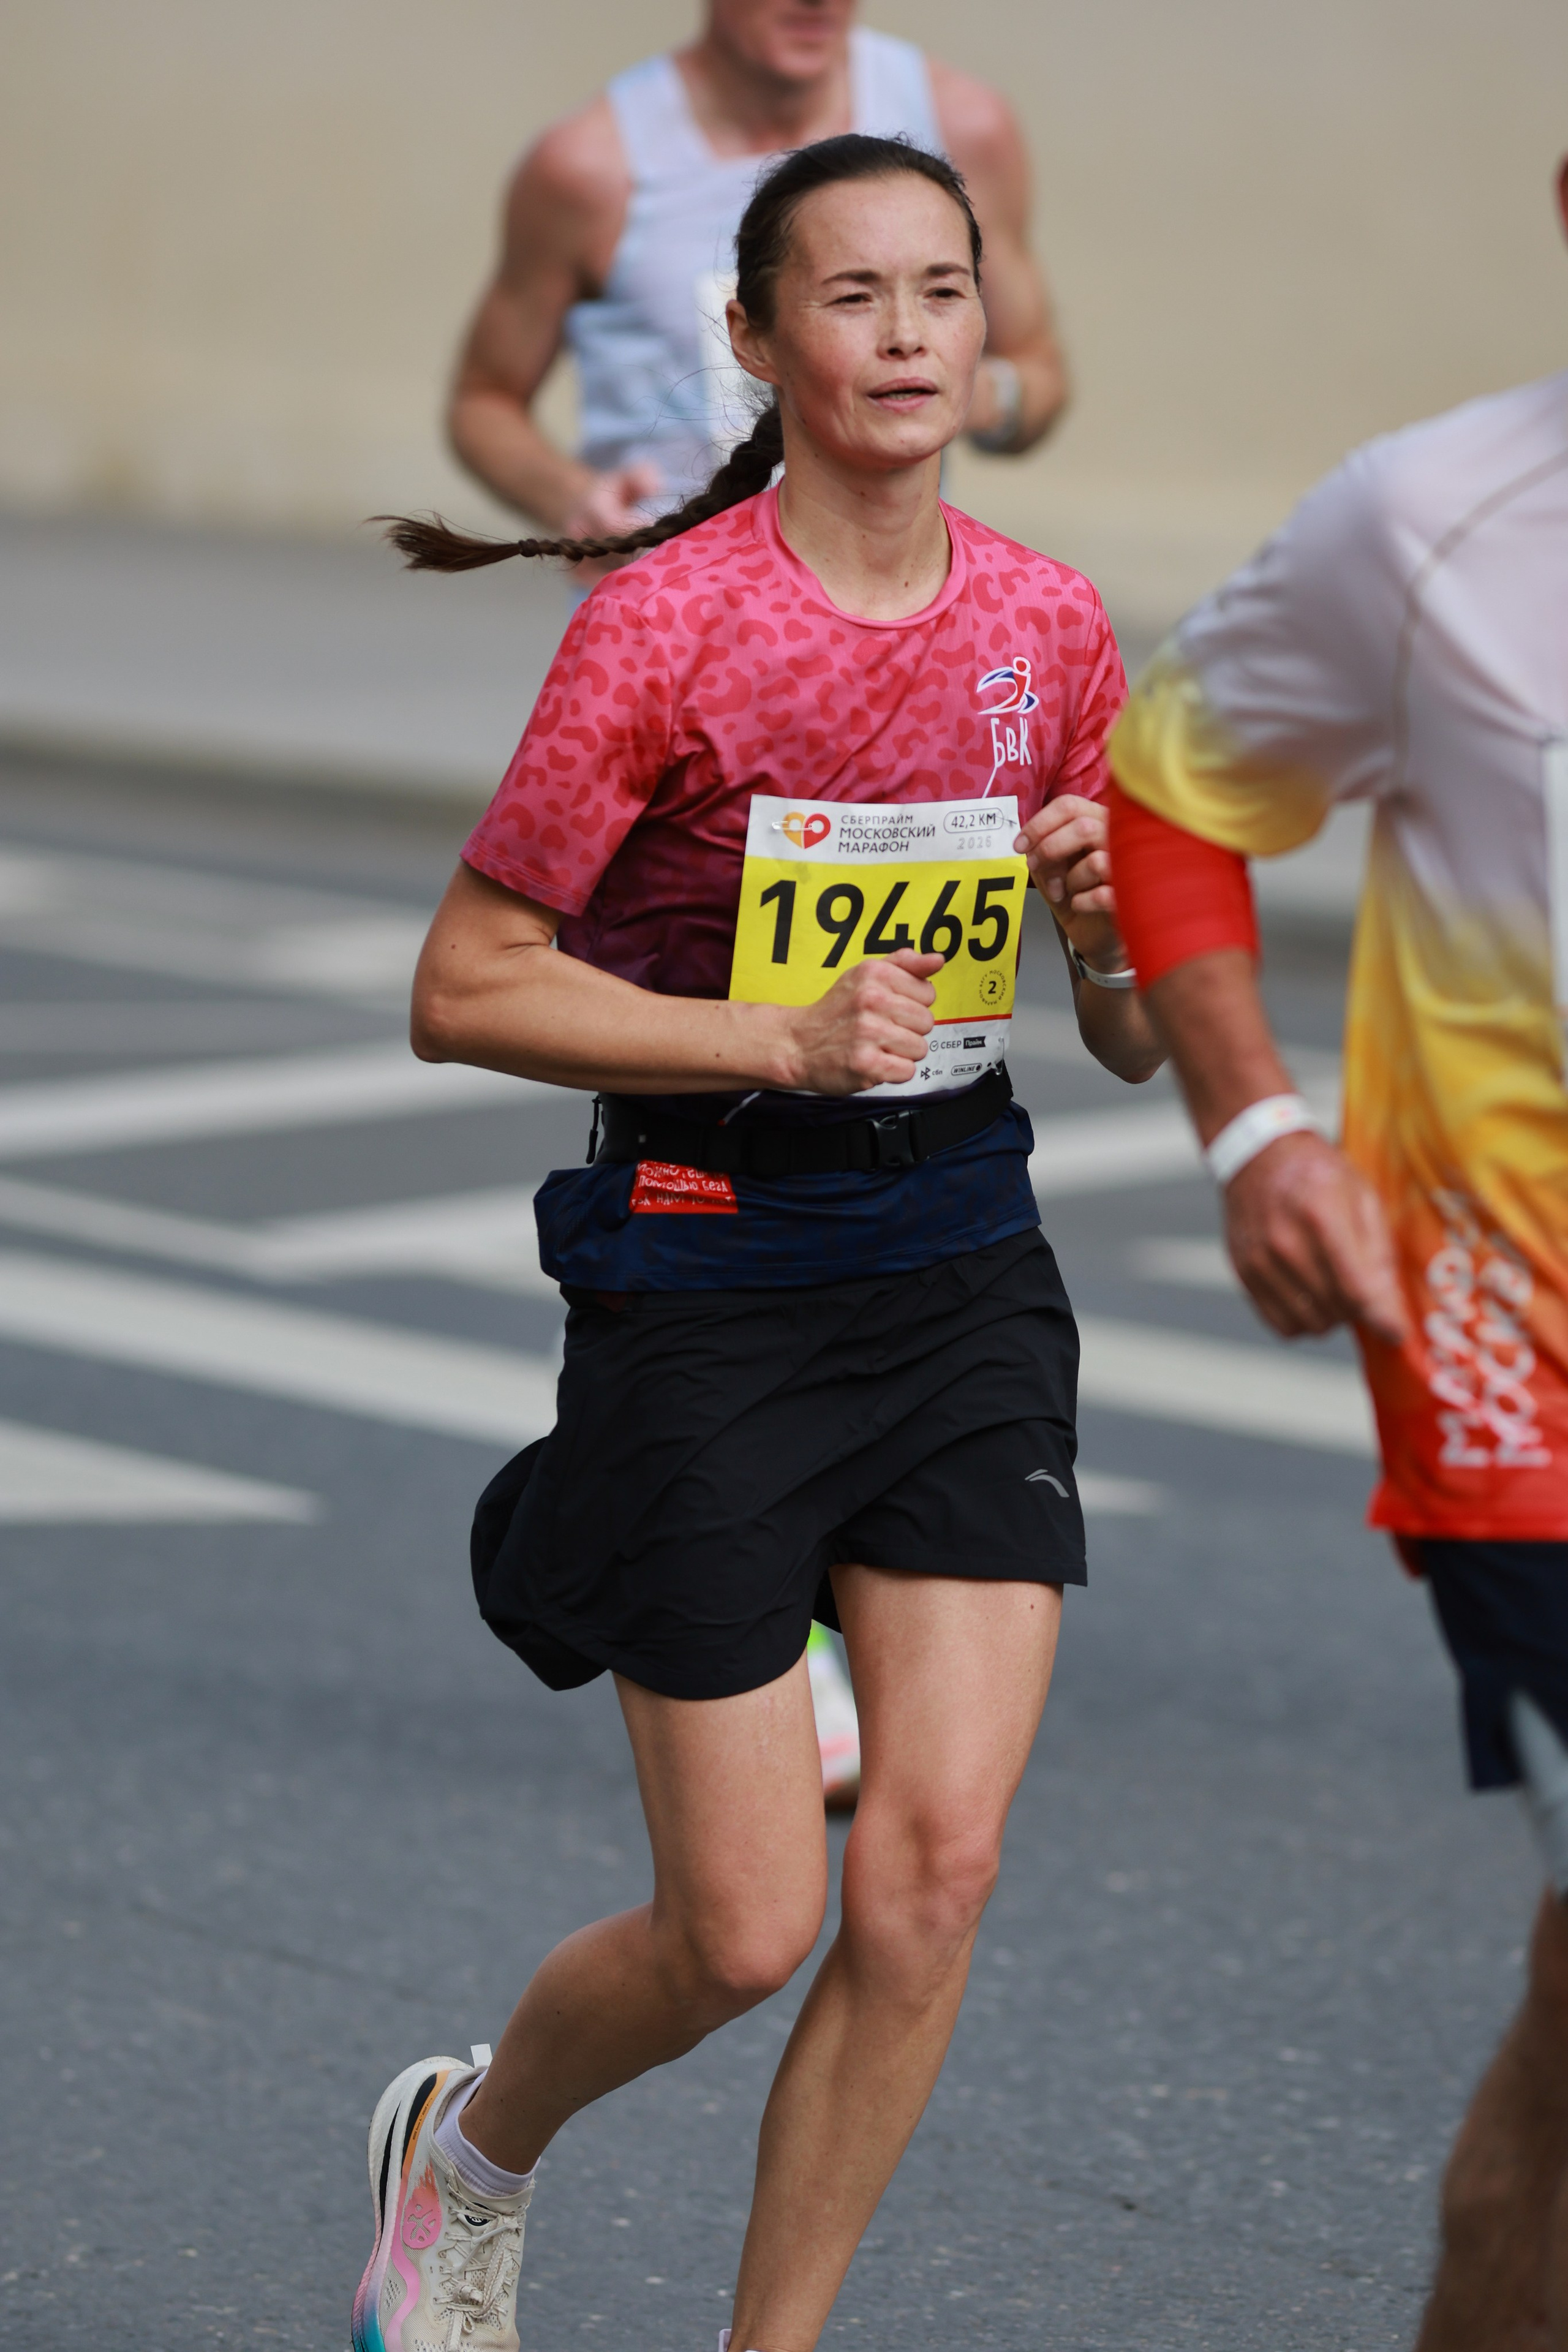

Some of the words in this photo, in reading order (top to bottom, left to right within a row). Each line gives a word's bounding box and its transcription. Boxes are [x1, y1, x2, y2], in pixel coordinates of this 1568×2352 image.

[841, 813, 913, 824] СБЕРПРАЙМ
[951, 814, 974, 829] 42,2
[840, 823, 935, 839] МОСКОВСКИЙ
[838, 841, 910, 853] МАРАФОН
[760, 876, 1015, 968] 19465
[988, 981, 997, 994] 2
[953, 1065, 975, 1074] WINLINE
